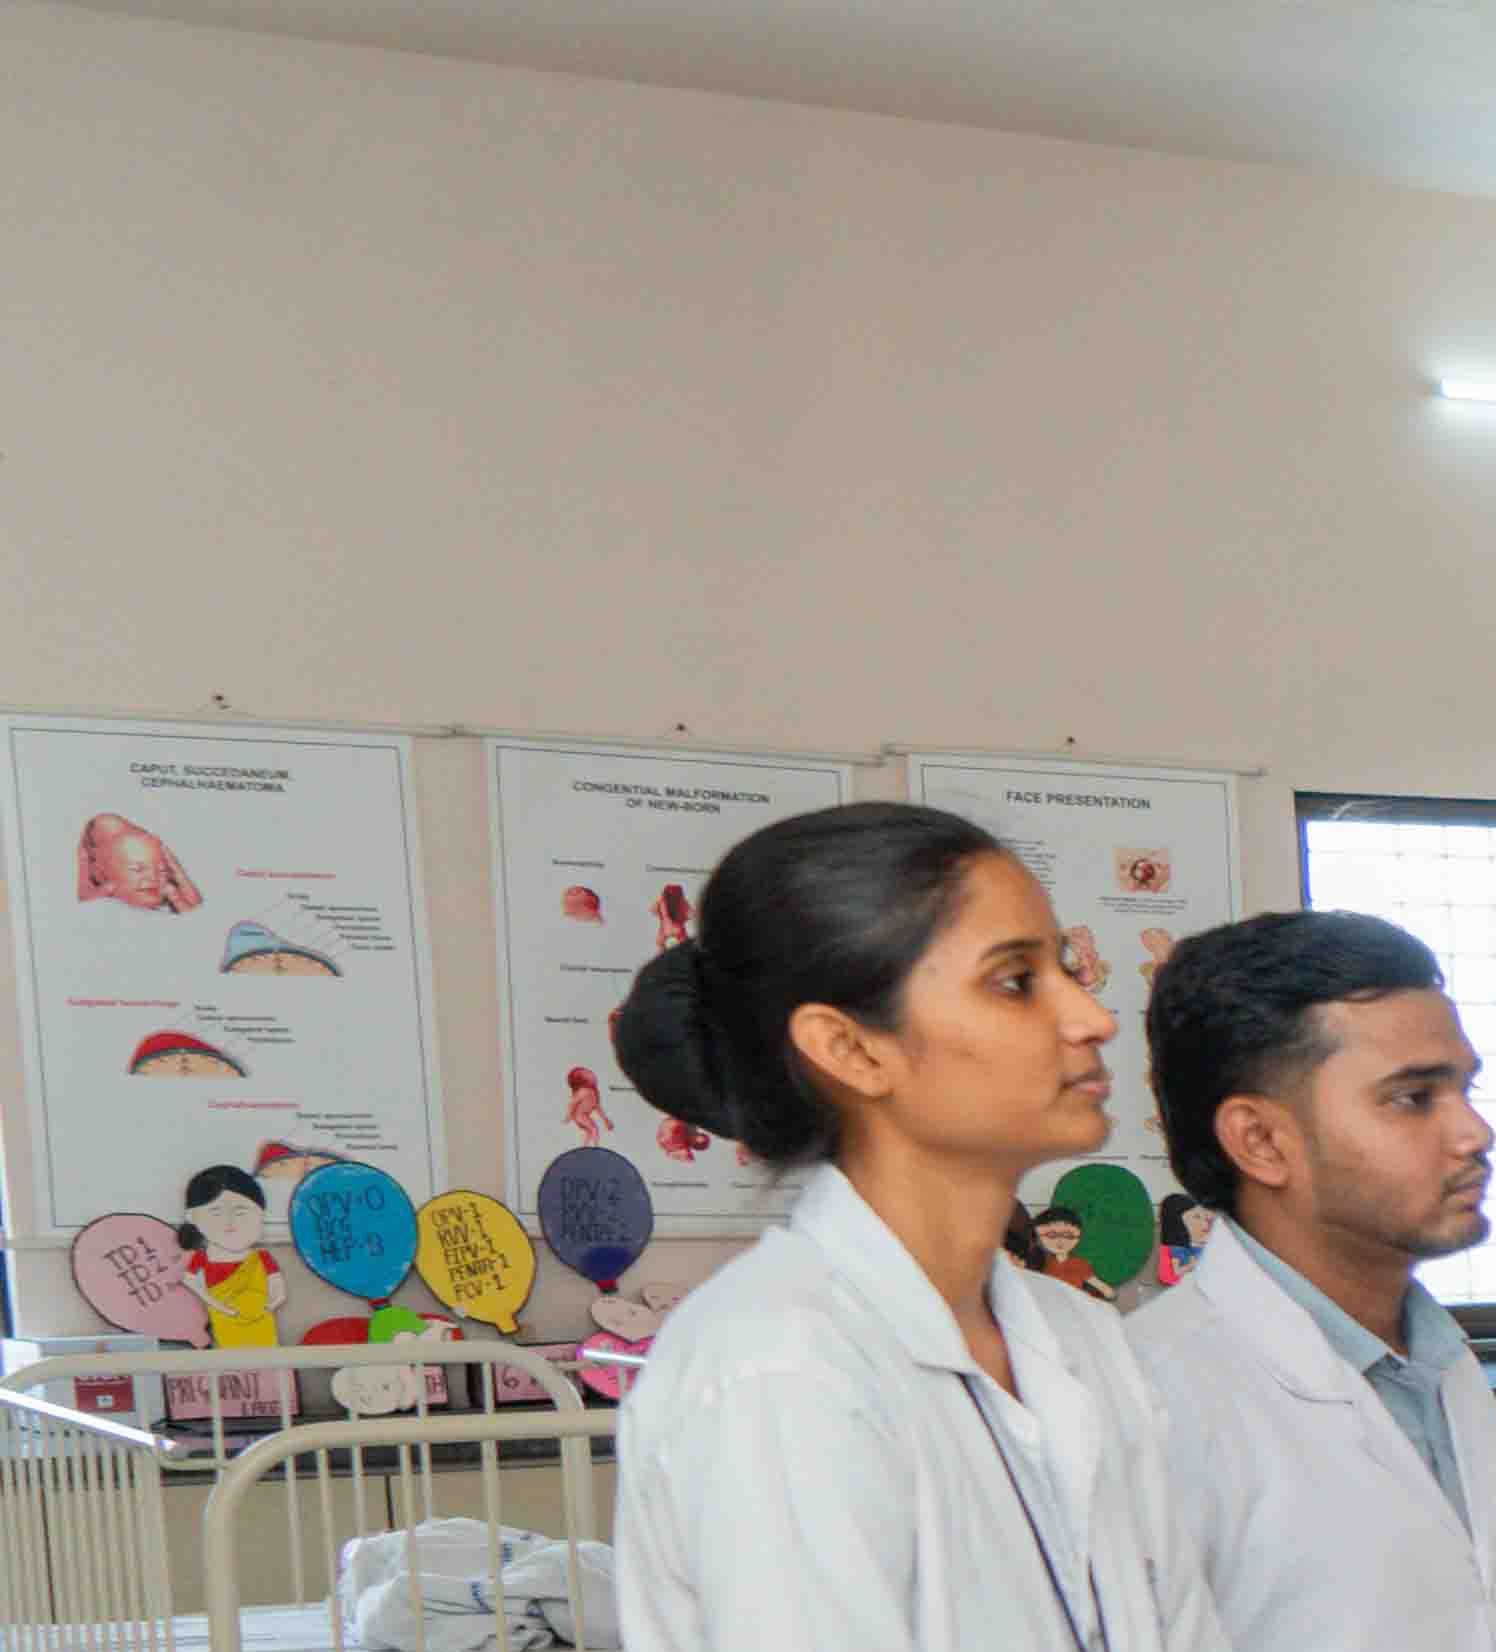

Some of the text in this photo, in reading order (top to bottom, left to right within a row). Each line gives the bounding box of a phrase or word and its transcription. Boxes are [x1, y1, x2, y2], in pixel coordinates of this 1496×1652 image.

[1007, 791, 1150, 809] FACE PRESENTATION
[167, 1370, 259, 1403] PREGANT
